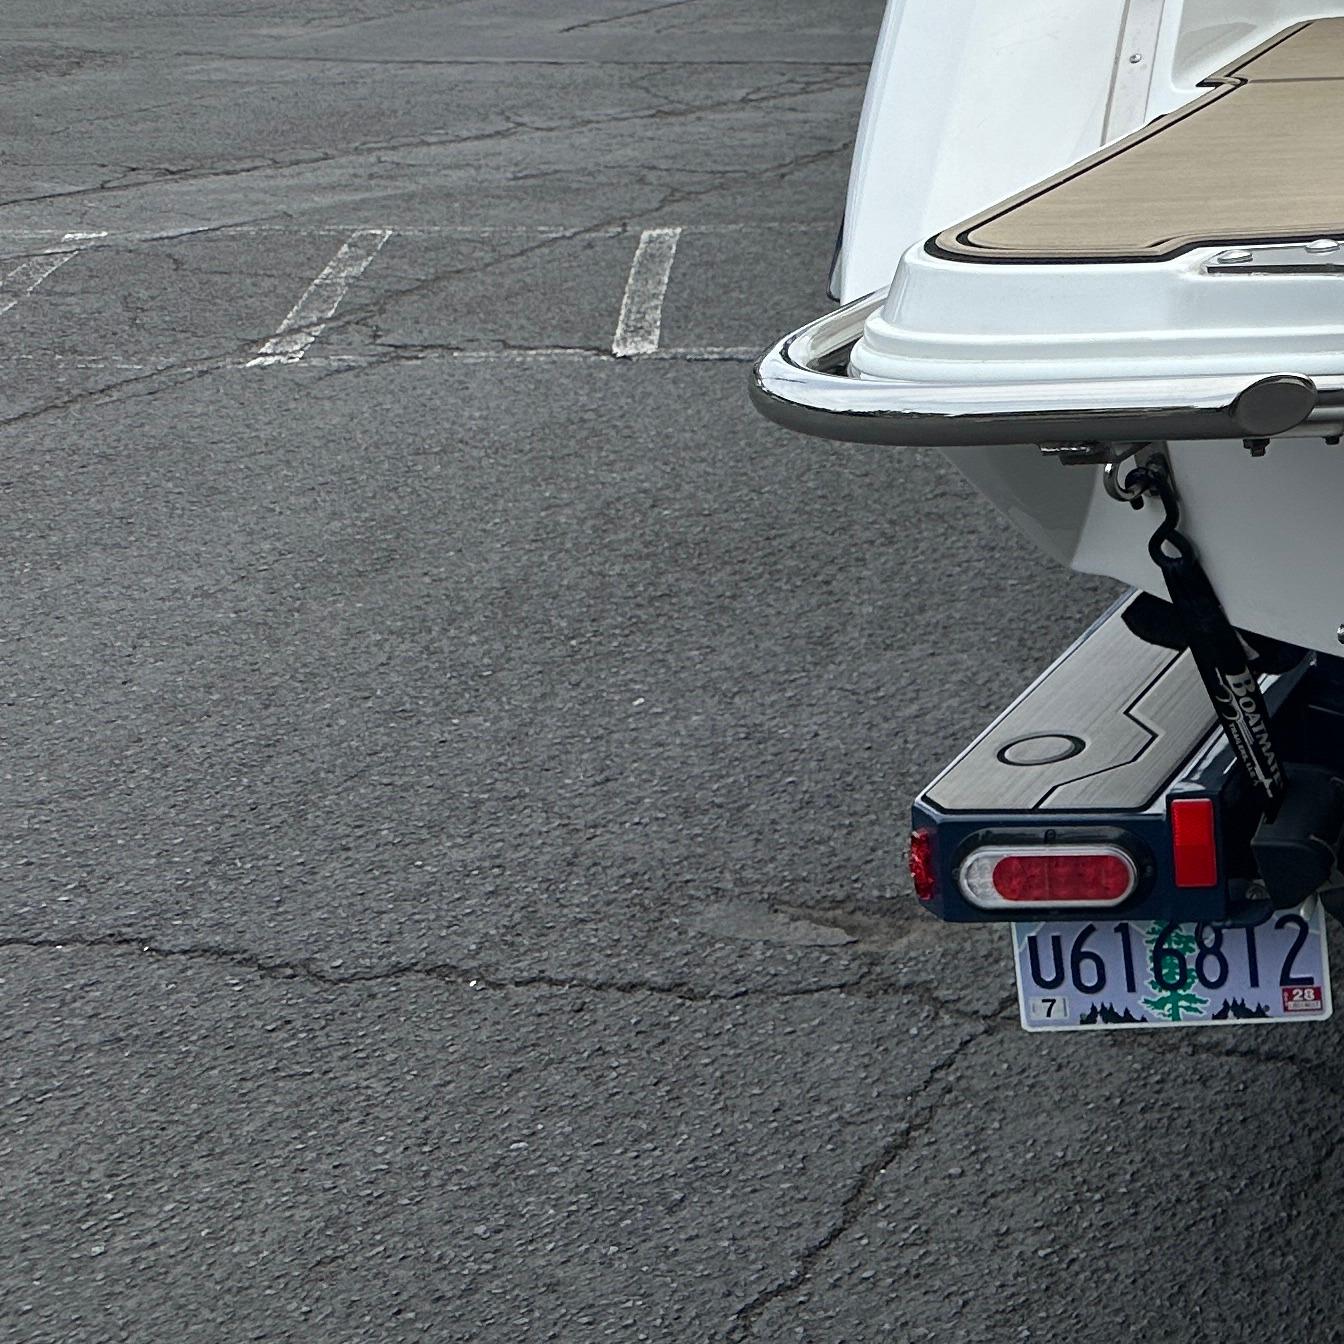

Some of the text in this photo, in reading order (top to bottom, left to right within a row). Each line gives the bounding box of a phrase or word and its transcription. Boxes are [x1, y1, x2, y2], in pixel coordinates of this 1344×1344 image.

[1027, 914, 1316, 994] U616812
[1292, 988, 1315, 1001] 28
[1041, 998, 1058, 1018] 7
